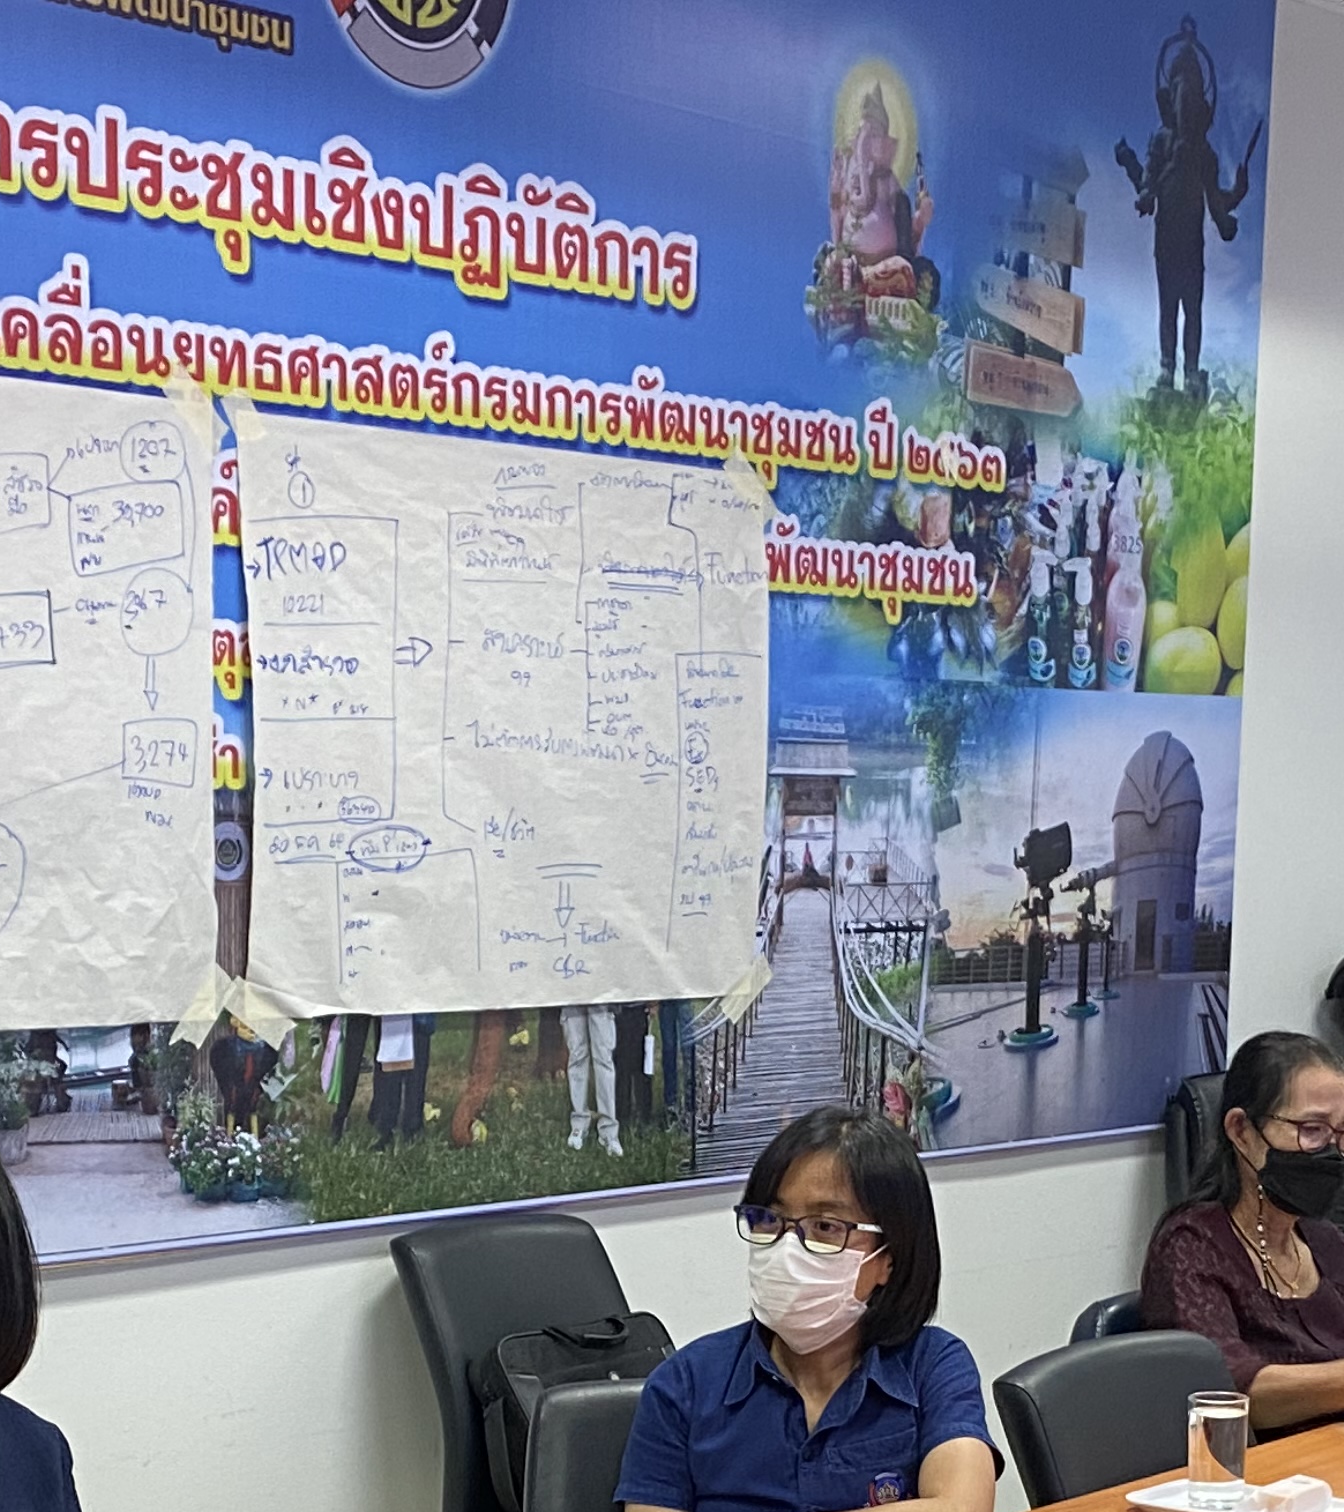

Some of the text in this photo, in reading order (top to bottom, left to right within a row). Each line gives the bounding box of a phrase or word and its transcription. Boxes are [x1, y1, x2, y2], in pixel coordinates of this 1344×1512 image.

[870, 405, 895, 471] ปี
[766, 522, 974, 615] พัฒนาชุมชน
